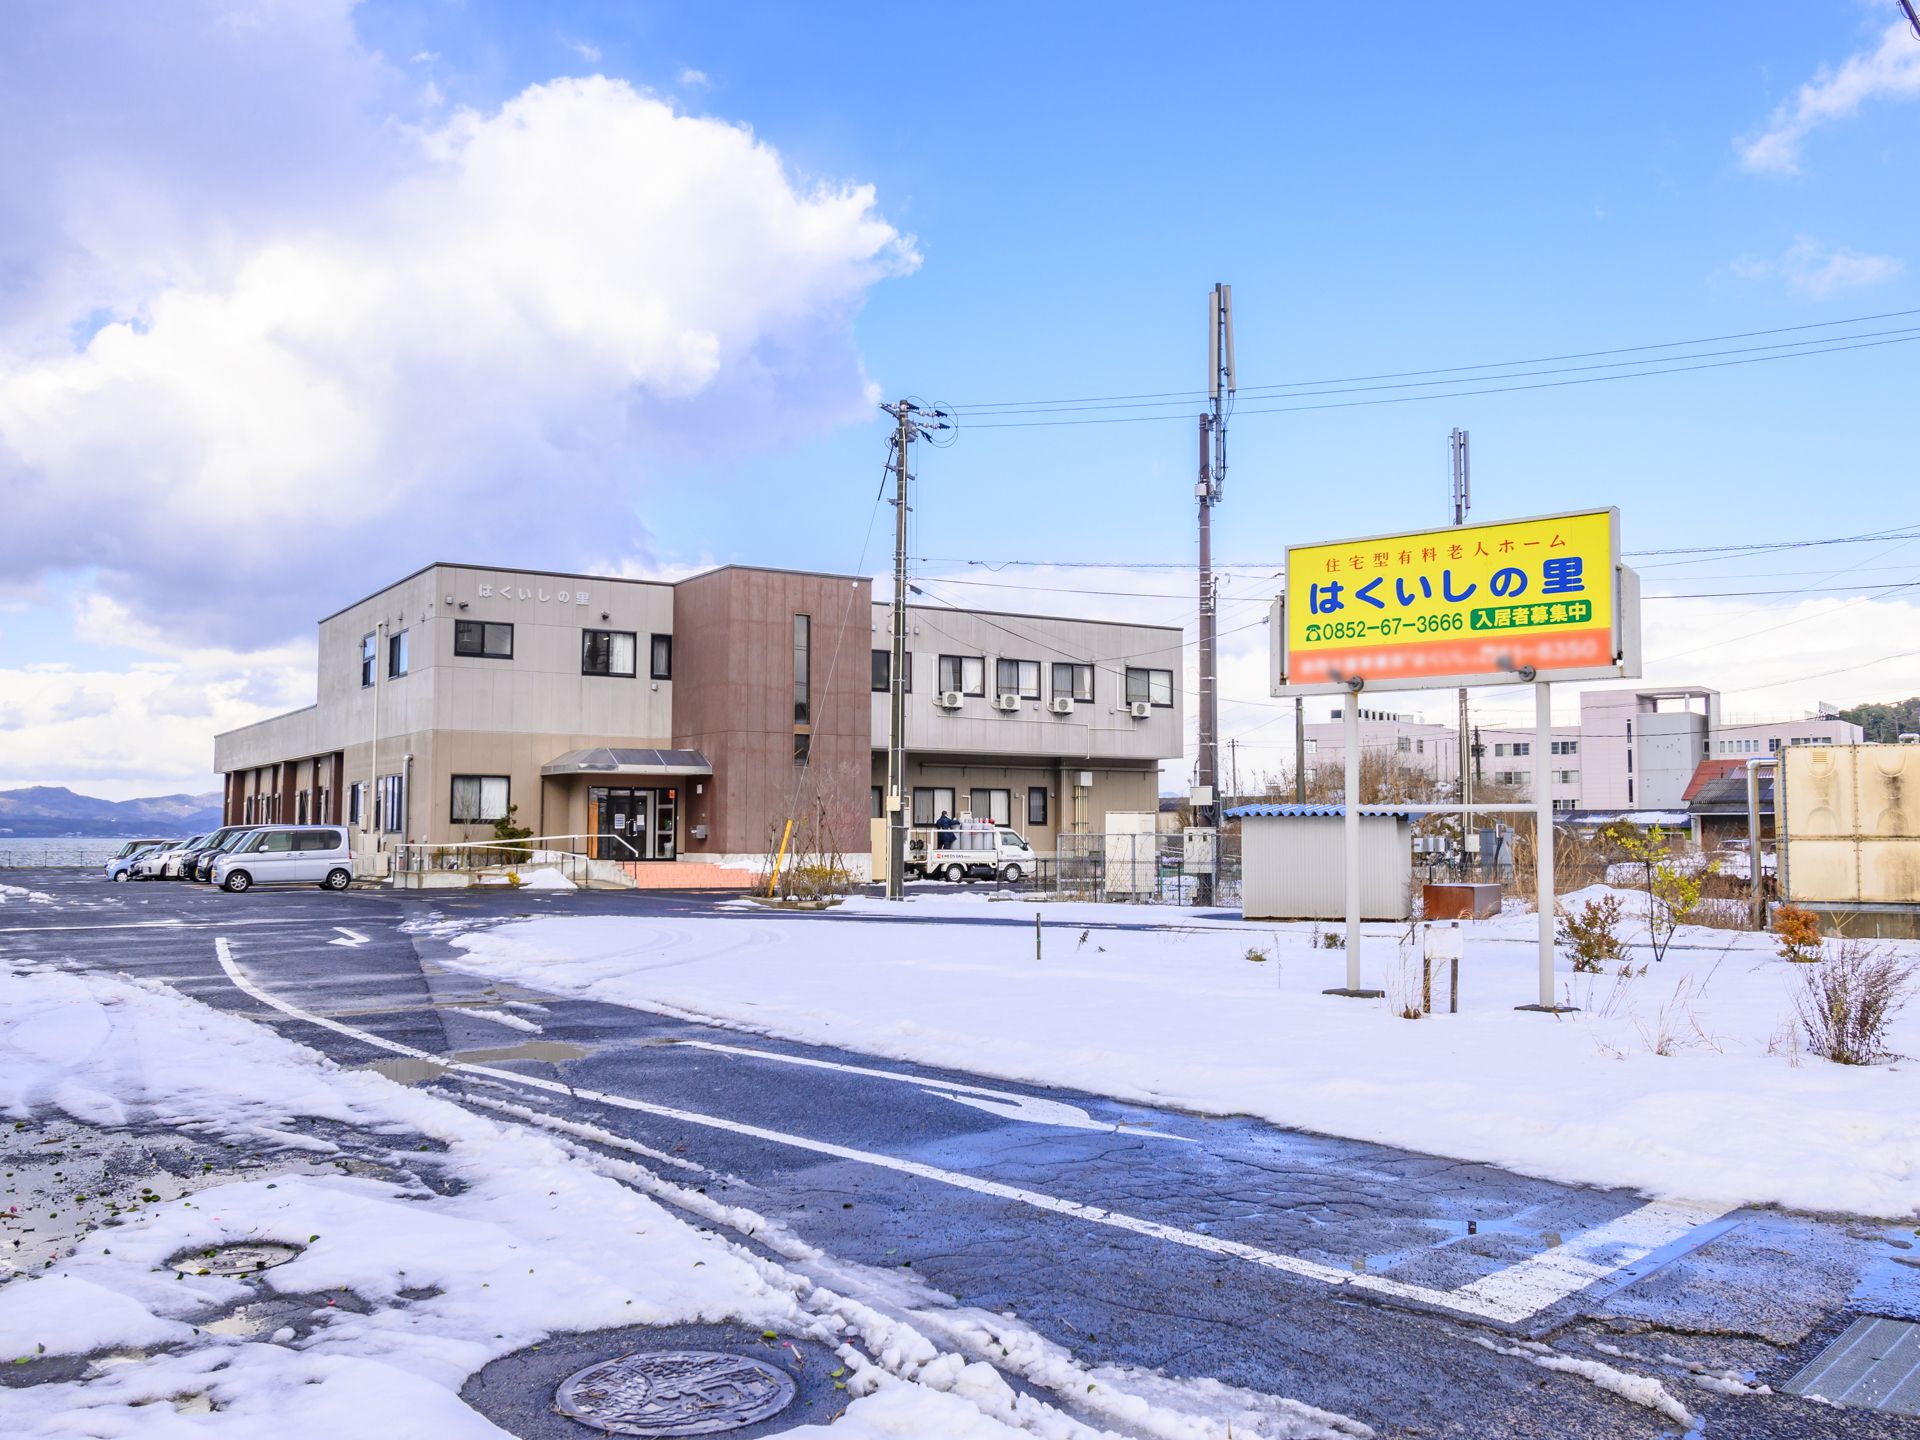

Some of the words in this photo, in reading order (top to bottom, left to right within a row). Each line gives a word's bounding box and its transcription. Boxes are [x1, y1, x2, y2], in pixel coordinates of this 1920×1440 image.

[1326, 534, 1567, 573] 住宅型有料老人ホーム
[478, 583, 591, 606] はくいしの里
[1309, 556, 1586, 615] はくいしの里
[1475, 601, 1588, 629] 入居者募集中
